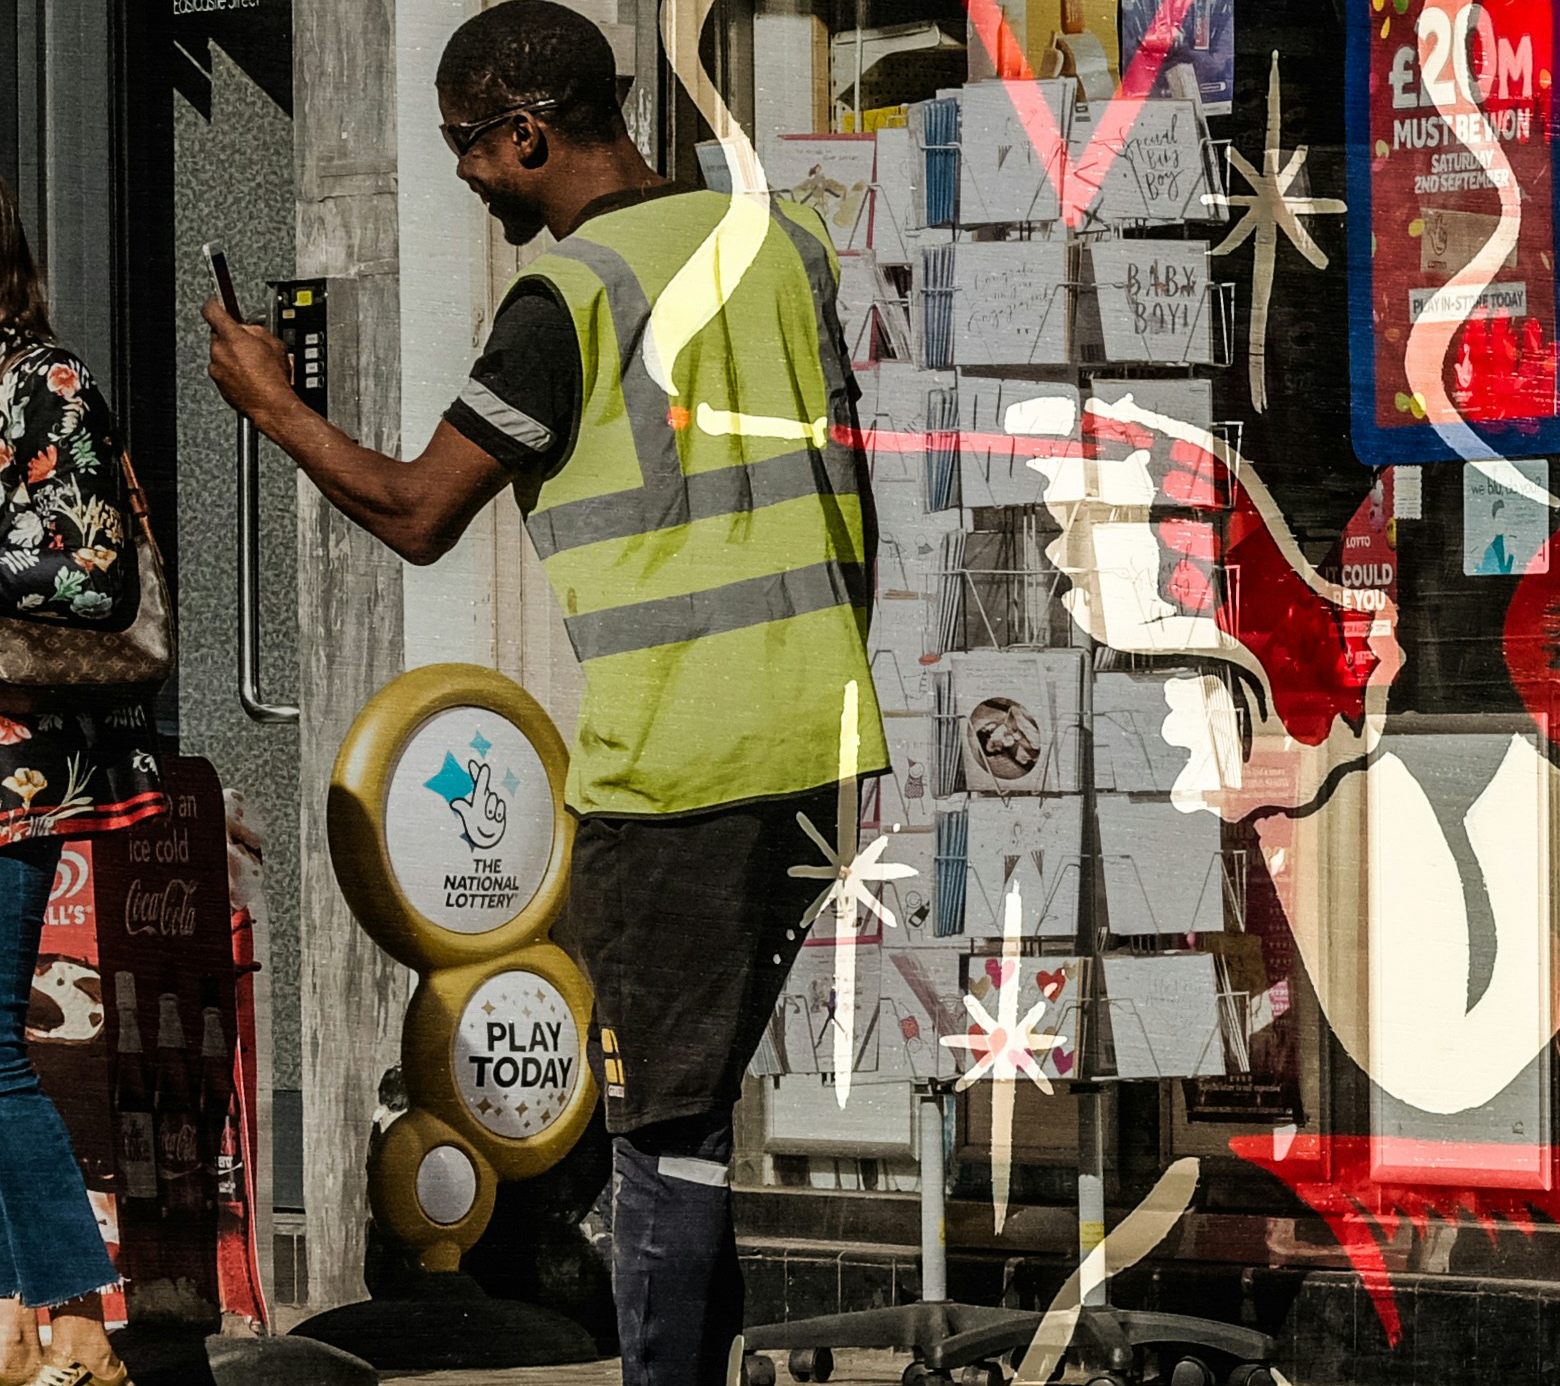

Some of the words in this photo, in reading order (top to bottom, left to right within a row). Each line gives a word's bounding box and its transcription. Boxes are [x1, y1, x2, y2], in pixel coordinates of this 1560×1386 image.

[1389, 3, 1533, 109] £20M
[1393, 115, 1453, 150] MUST
[1455, 113, 1482, 144] BE
[1483, 108, 1531, 142] WON
[1431, 149, 1495, 173] SATURDAY
[1145, 169, 1185, 201] Boy
[1414, 174, 1441, 194] 2ND
[1440, 168, 1510, 192] SEPTEMBER
[1126, 262, 1197, 298] BABY
[1413, 298, 1440, 314] PLAY
[1441, 294, 1489, 312] IN-STORE
[1490, 291, 1524, 308] TODAY
[1132, 303, 1189, 335] BOY!
[1471, 485, 1485, 495] we
[179, 794, 198, 819] an
[129, 832, 151, 863] ice
[155, 828, 190, 863] cold
[473, 859, 503, 873] THE
[443, 875, 520, 892] NATIONAL
[445, 892, 515, 909] LOTTERY
[43, 905, 86, 926] LL'S
[486, 1022, 562, 1053] PLAY
[468, 1056, 573, 1089] TODAY
